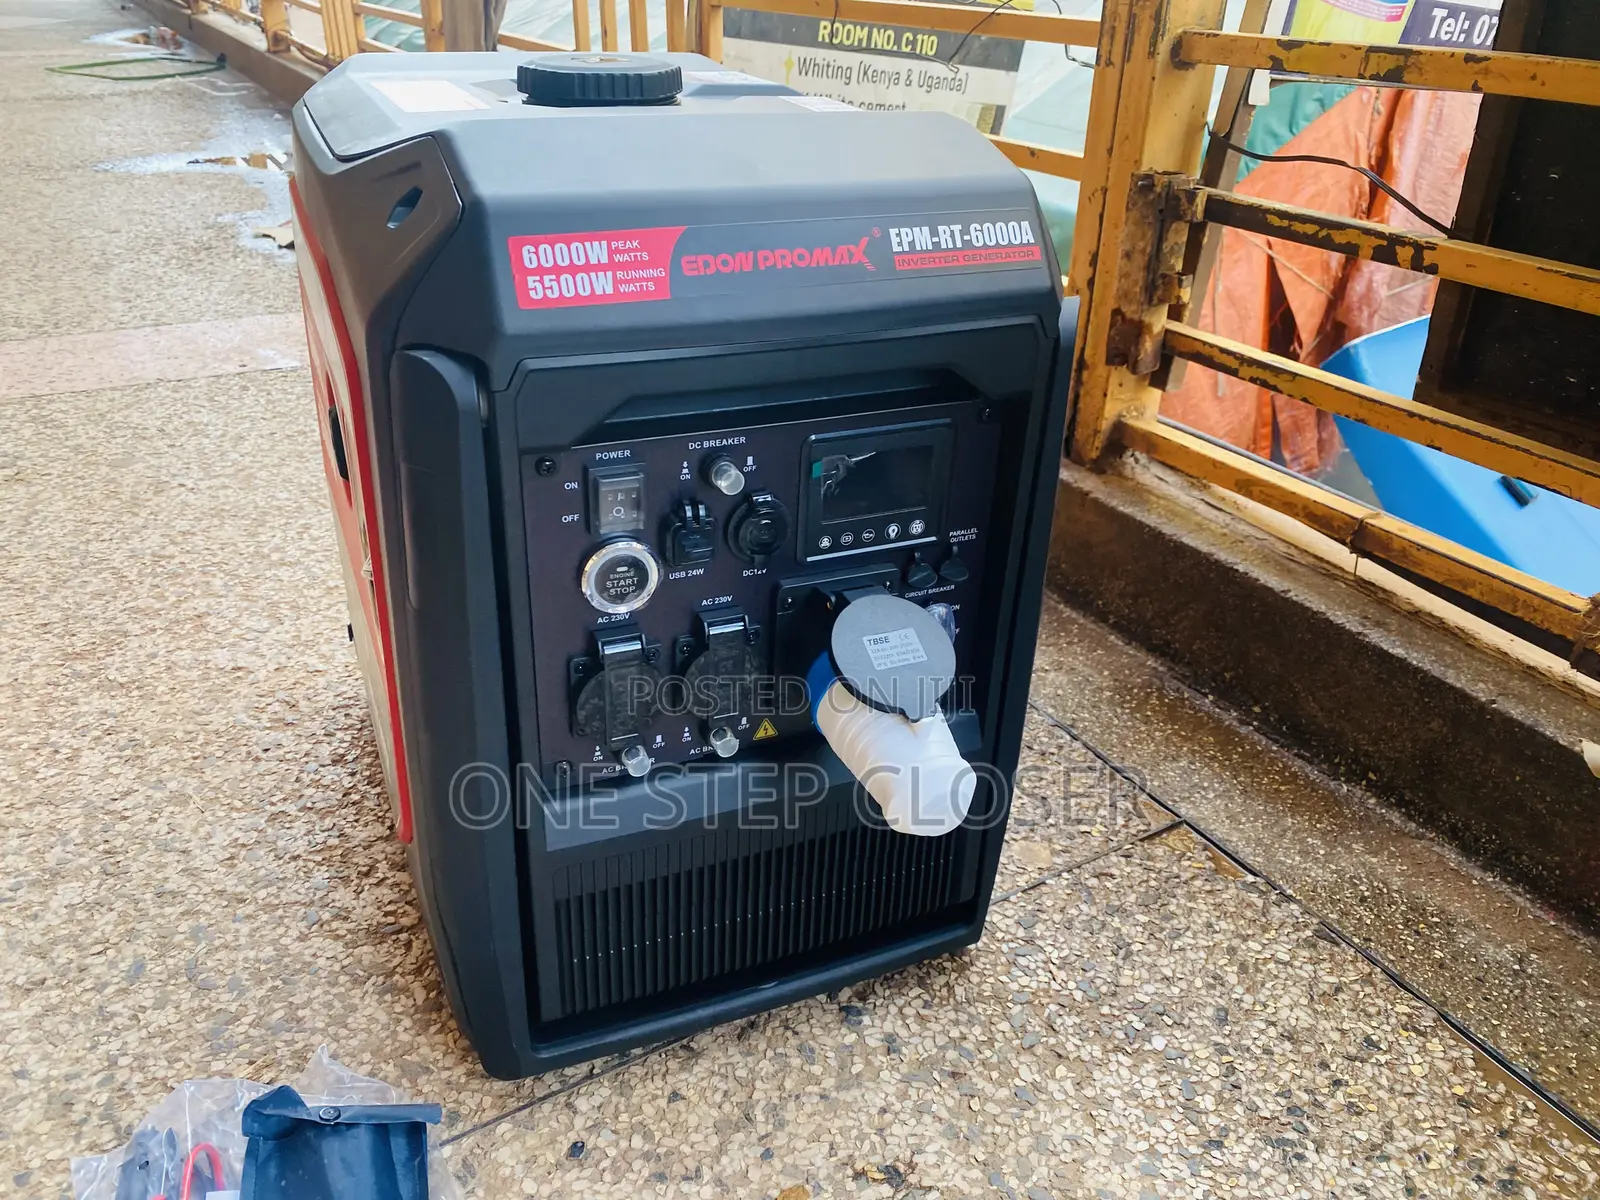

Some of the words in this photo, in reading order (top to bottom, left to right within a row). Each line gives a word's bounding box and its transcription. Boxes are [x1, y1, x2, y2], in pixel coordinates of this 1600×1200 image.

[1429, 7, 1470, 43] Tel:
[818, 21, 868, 47] ROOM
[871, 28, 898, 50] NO.
[902, 32, 913, 53] C
[916, 34, 938, 56] 110
[797, 56, 852, 86] Whiting
[856, 60, 900, 90] (Kenya
[904, 68, 913, 87] &
[918, 70, 969, 95] Uganda)
[889, 220, 1035, 253] EPM-RT-6000A
[612, 240, 641, 250] PEAK
[522, 240, 609, 269] 6000W
[613, 252, 649, 262] WATTS
[681, 251, 753, 276] EDON
[757, 237, 876, 272] PROMAX
[899, 254, 960, 268] INVERTER
[963, 250, 1035, 263] GENERATOR
[616, 268, 665, 280] RUNNING
[527, 271, 614, 300] 5500W
[618, 282, 655, 293] WATTS
[688, 441, 702, 450] DC
[704, 436, 746, 448] BREAKER
[596, 450, 631, 460] POWER
[564, 482, 578, 490] ON
[562, 514, 580, 523] OFF
[949, 528, 978, 537] PARALLEL
[950, 534, 976, 543] OUTLETS
[610, 572, 634, 580] ENGINE
[669, 571, 686, 580] USB
[688, 568, 704, 577] 24W
[606, 578, 638, 588] START
[609, 586, 636, 596] STOP
[905, 590, 927, 598] CIRCUIT
[928, 585, 955, 594] BREAKER
[702, 597, 713, 606] AC
[714, 595, 733, 604] 230V
[597, 615, 610, 624] AC
[611, 612, 630, 622] 230V
[867, 636, 890, 646] TBSE
[602, 766, 614, 774] AC
